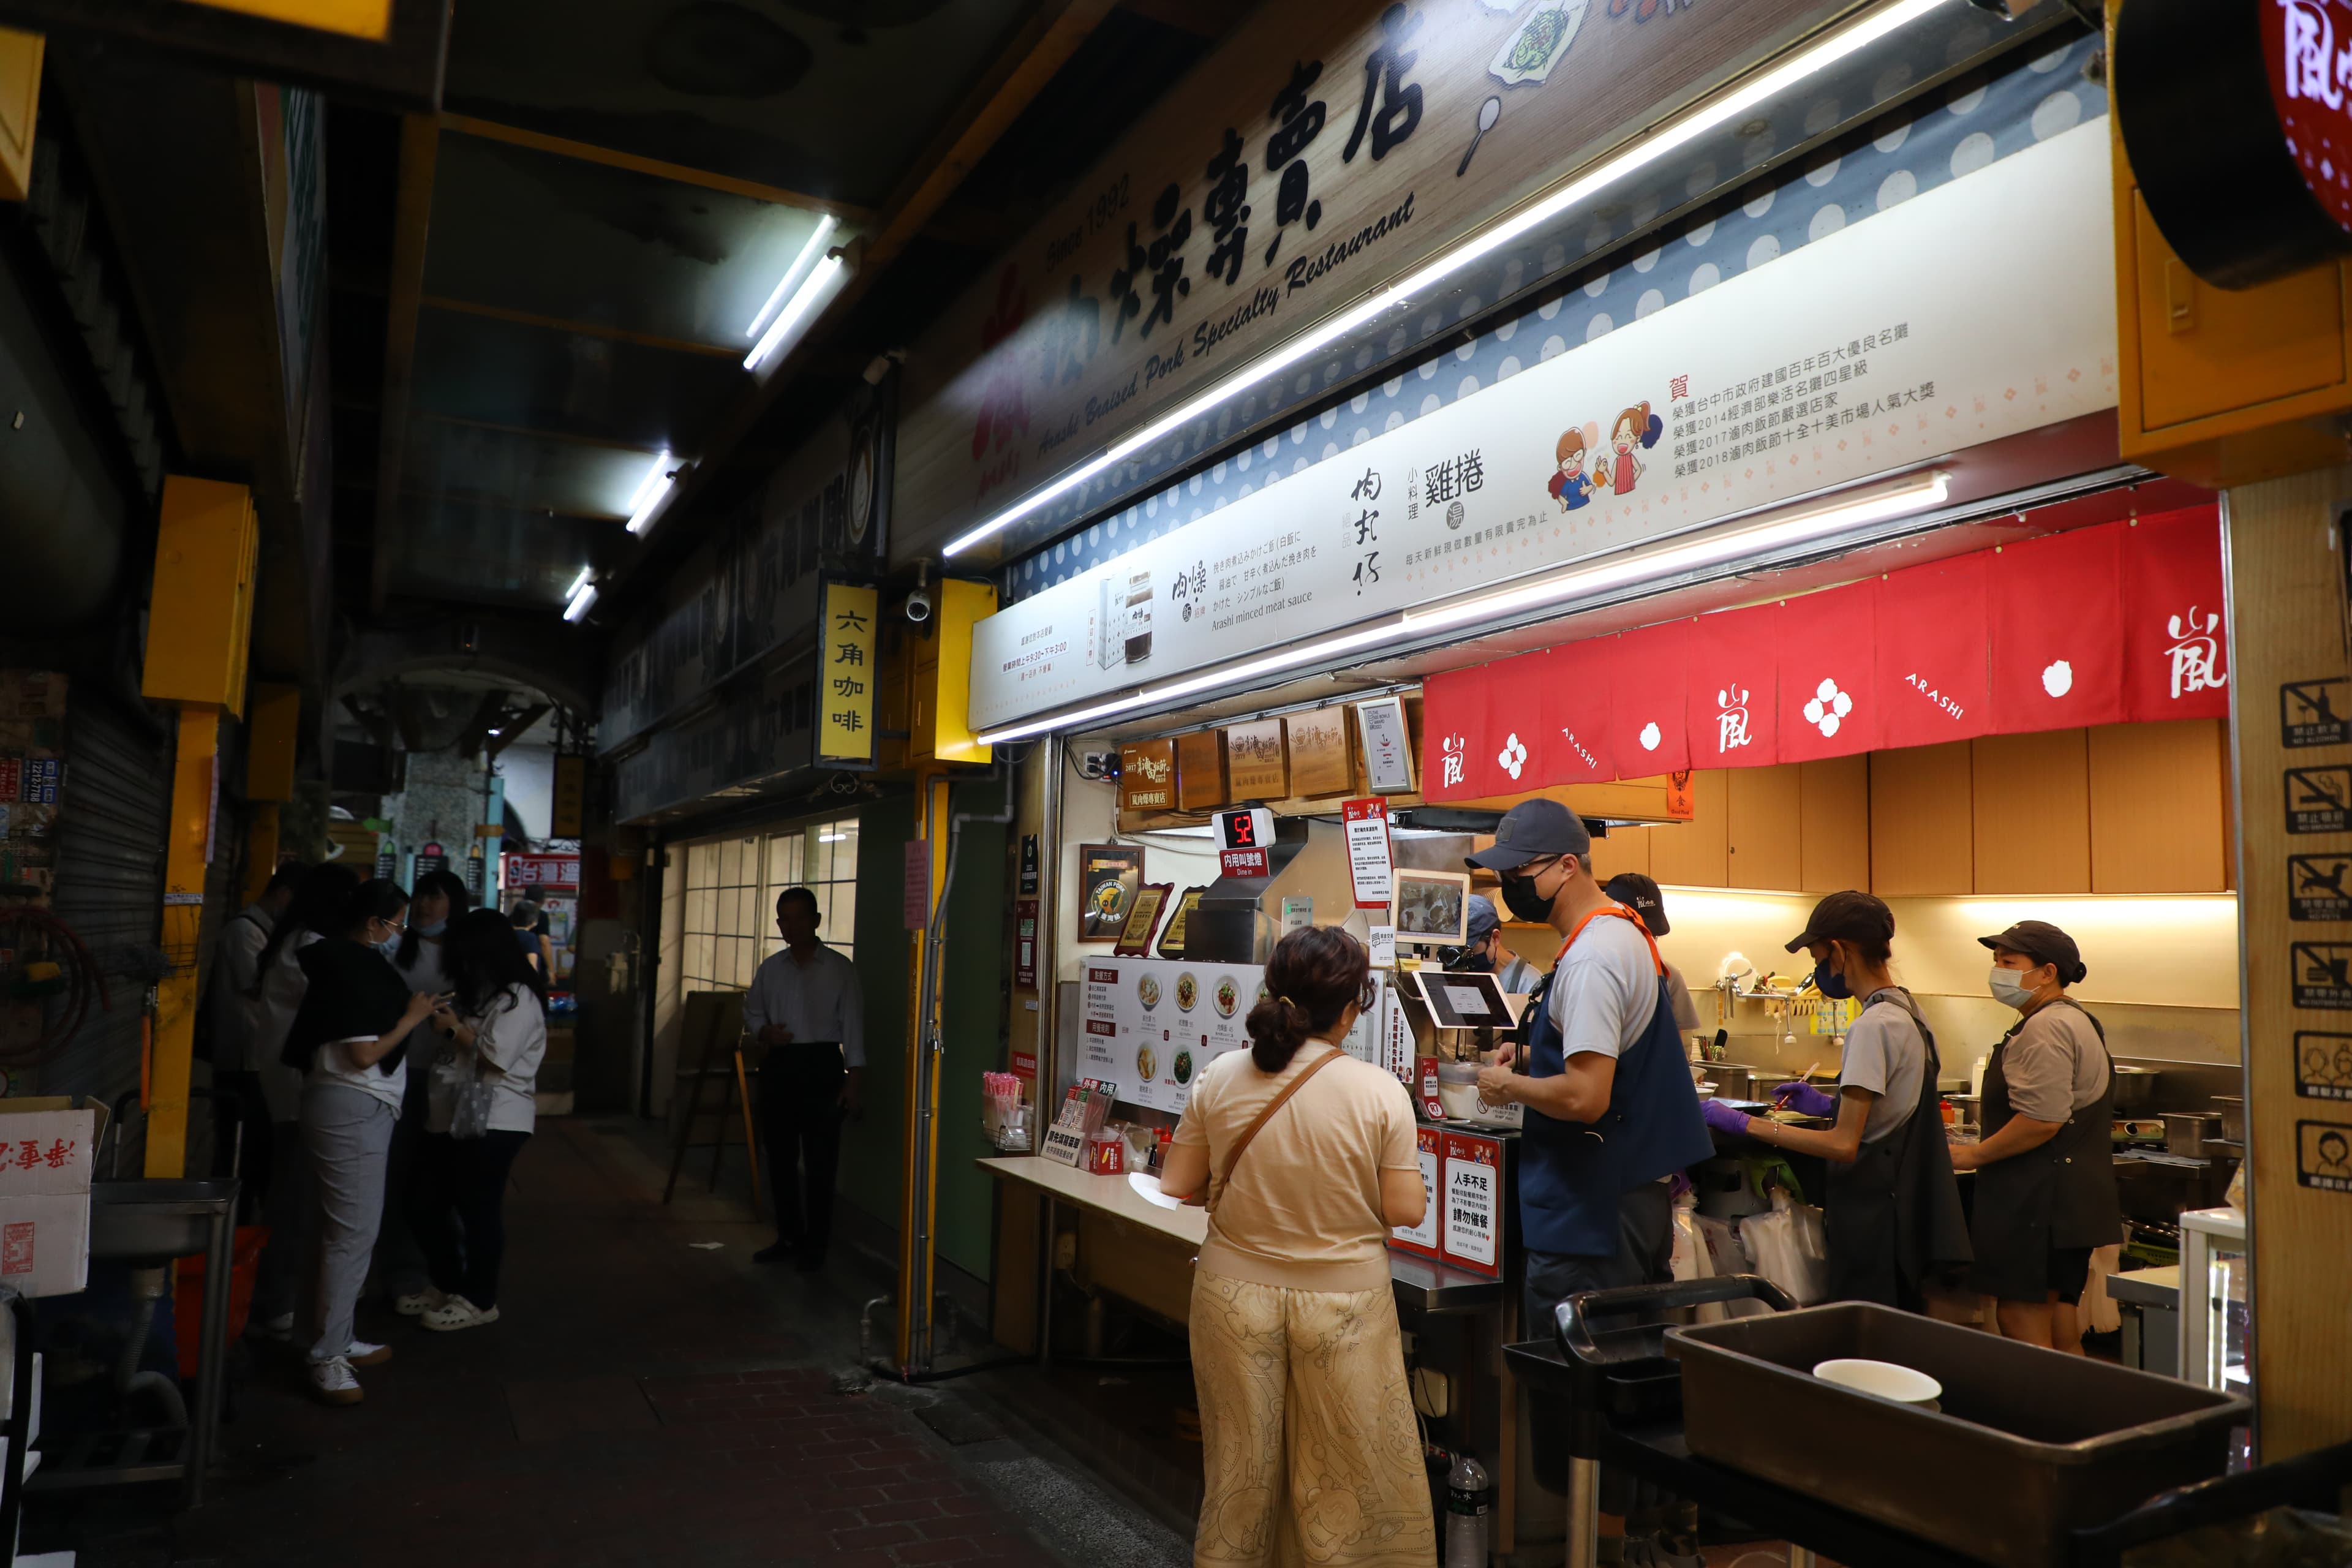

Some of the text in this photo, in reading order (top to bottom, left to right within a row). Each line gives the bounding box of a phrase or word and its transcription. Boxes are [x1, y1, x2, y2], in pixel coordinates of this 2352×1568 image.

[1045, 173, 1130, 272] Since 1992
[1085, 372, 1138, 424] Braised
[1146, 338, 1186, 389] Pork
[1193, 286, 1281, 358] Specialty
[1286, 191, 1415, 298] Restaurant
[1670, 374, 1689, 403] 賀
[1408, 467, 1419, 521] 小料理
[1425, 448, 1483, 508] 雞捲
[1447, 502, 1464, 529] 湯
[1405, 510, 1548, 566] 每天新鮮現做數量有限賣完為止
[1172, 559, 1207, 603] 肉燥
[1212, 590, 1313, 632] Arashi minced meat sauce
[832, 610, 869, 733] 六角咖啡
[2164, 605, 2226, 699] 嵐
[1905, 672, 1964, 720] ARASHI
[1716, 683, 1752, 753] 嵐
[1442, 732, 1464, 788] 嵐
[1562, 727, 1597, 769] ARASHI
[1224, 852, 1262, 868] 內用叫號燈
[1096, 881, 1126, 895] TAIWAN PORK
[1082, 1078, 1098, 1091] 外帶
[1099, 1082, 1115, 1096] 內用
[1429, 1104, 1438, 1113] R7
[1454, 1171, 1488, 1191] 人手不足
[1453, 1207, 1488, 1229] 請勿催餐
